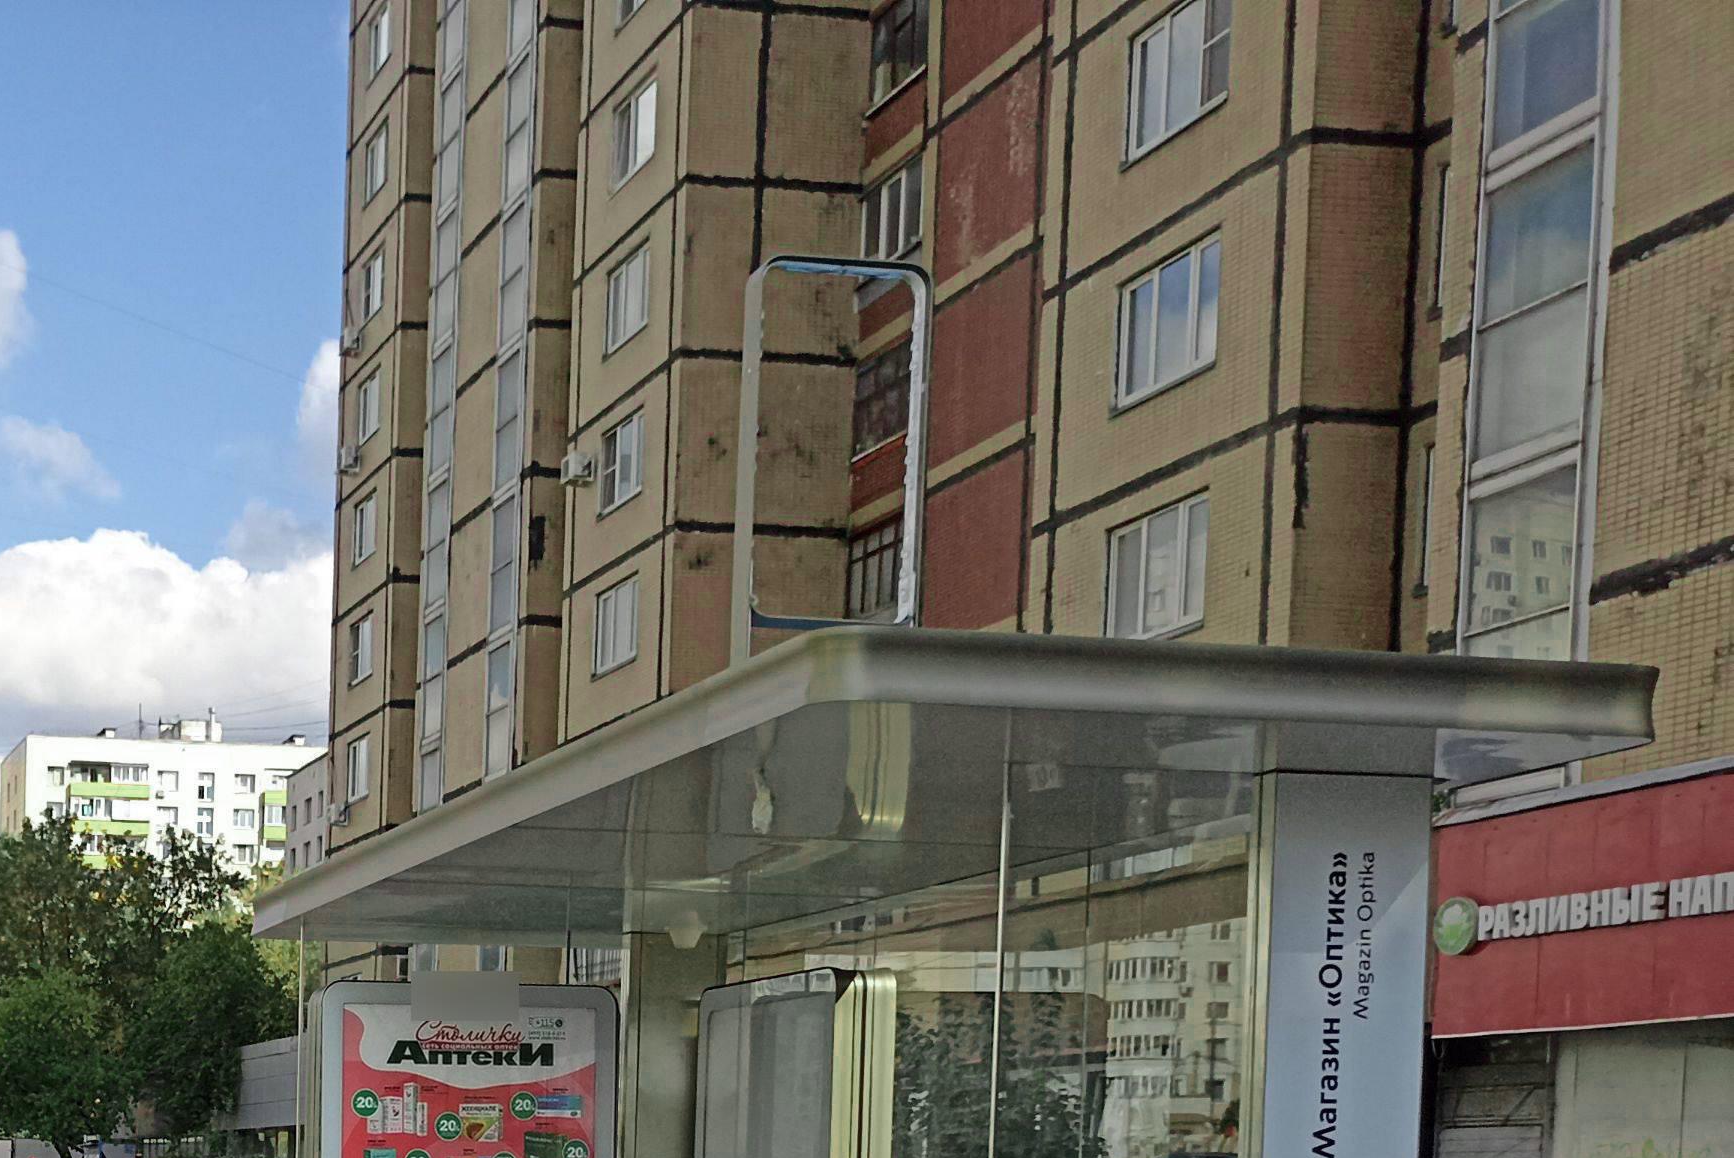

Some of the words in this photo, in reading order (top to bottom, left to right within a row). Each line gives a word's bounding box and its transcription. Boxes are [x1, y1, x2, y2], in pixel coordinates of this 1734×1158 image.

[1357, 852, 1375, 922] Optika
[1477, 881, 1666, 941] РАЗЛИВНЫЕ
[1668, 871, 1734, 918] НАП
[1319, 852, 1348, 1007] «Оптика»
[1353, 929, 1374, 1019] Magazin
[415, 1020, 526, 1043] Столички
